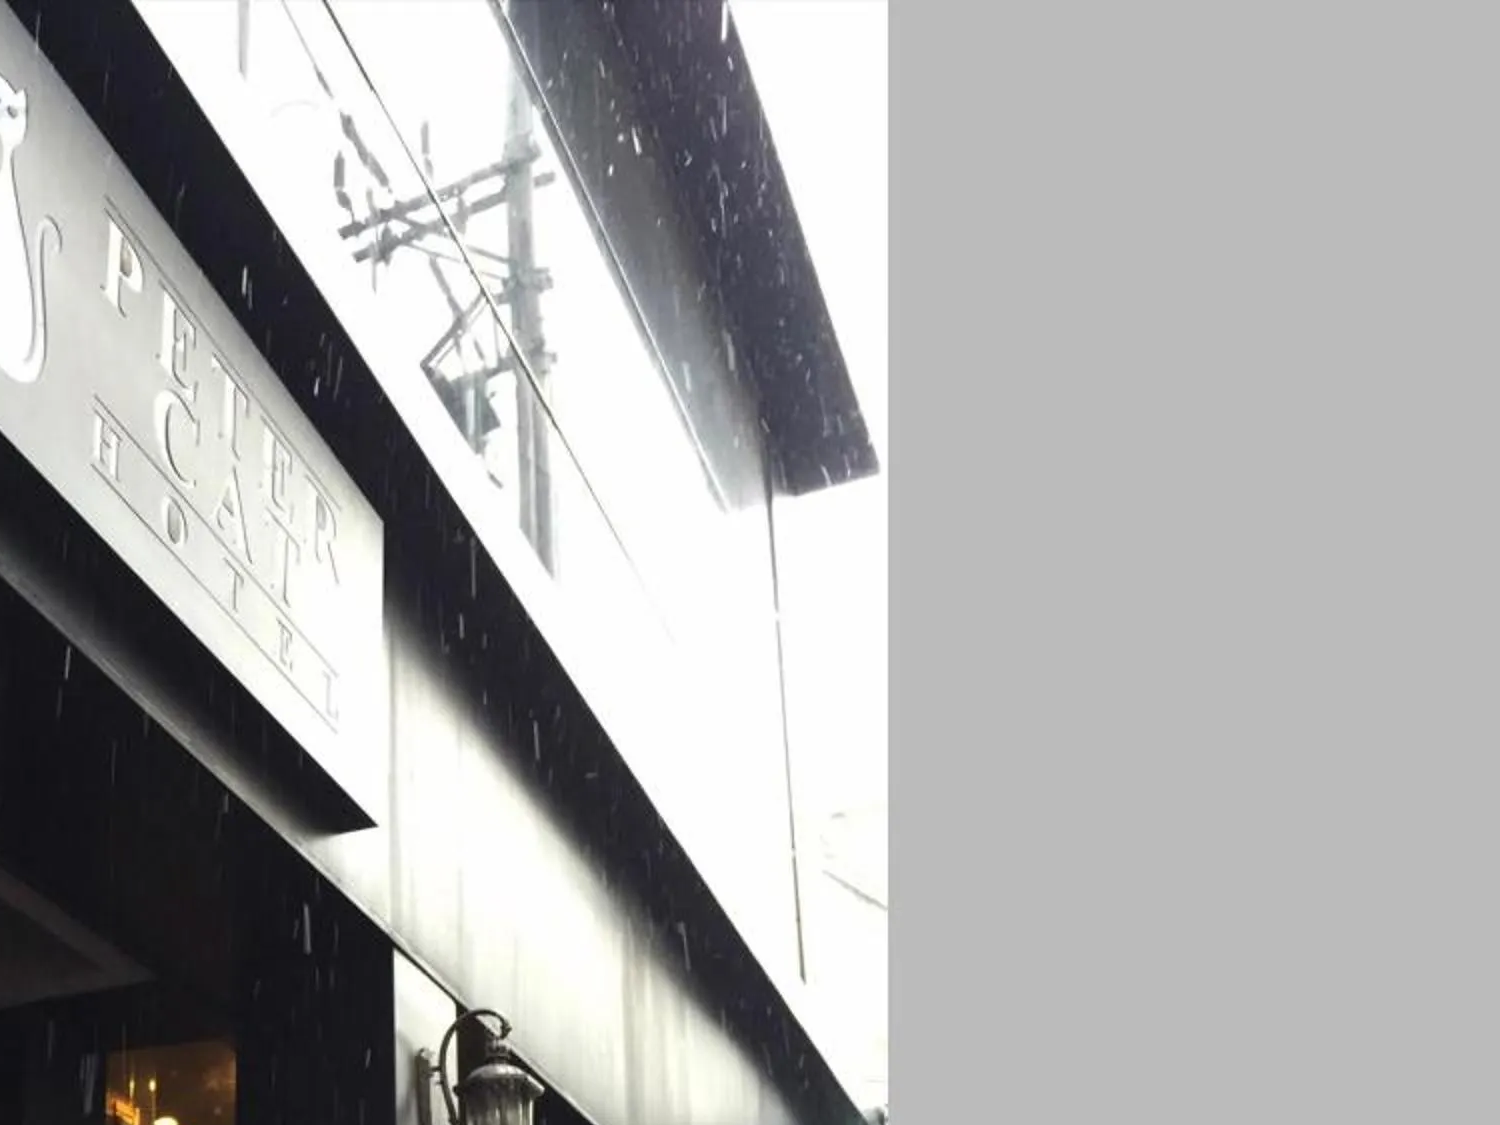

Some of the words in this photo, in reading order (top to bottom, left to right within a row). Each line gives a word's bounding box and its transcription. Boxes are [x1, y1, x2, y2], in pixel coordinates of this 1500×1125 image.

[100, 208, 340, 584] PETER
[154, 389, 298, 608] CAT
[93, 405, 339, 720] HOTEL
